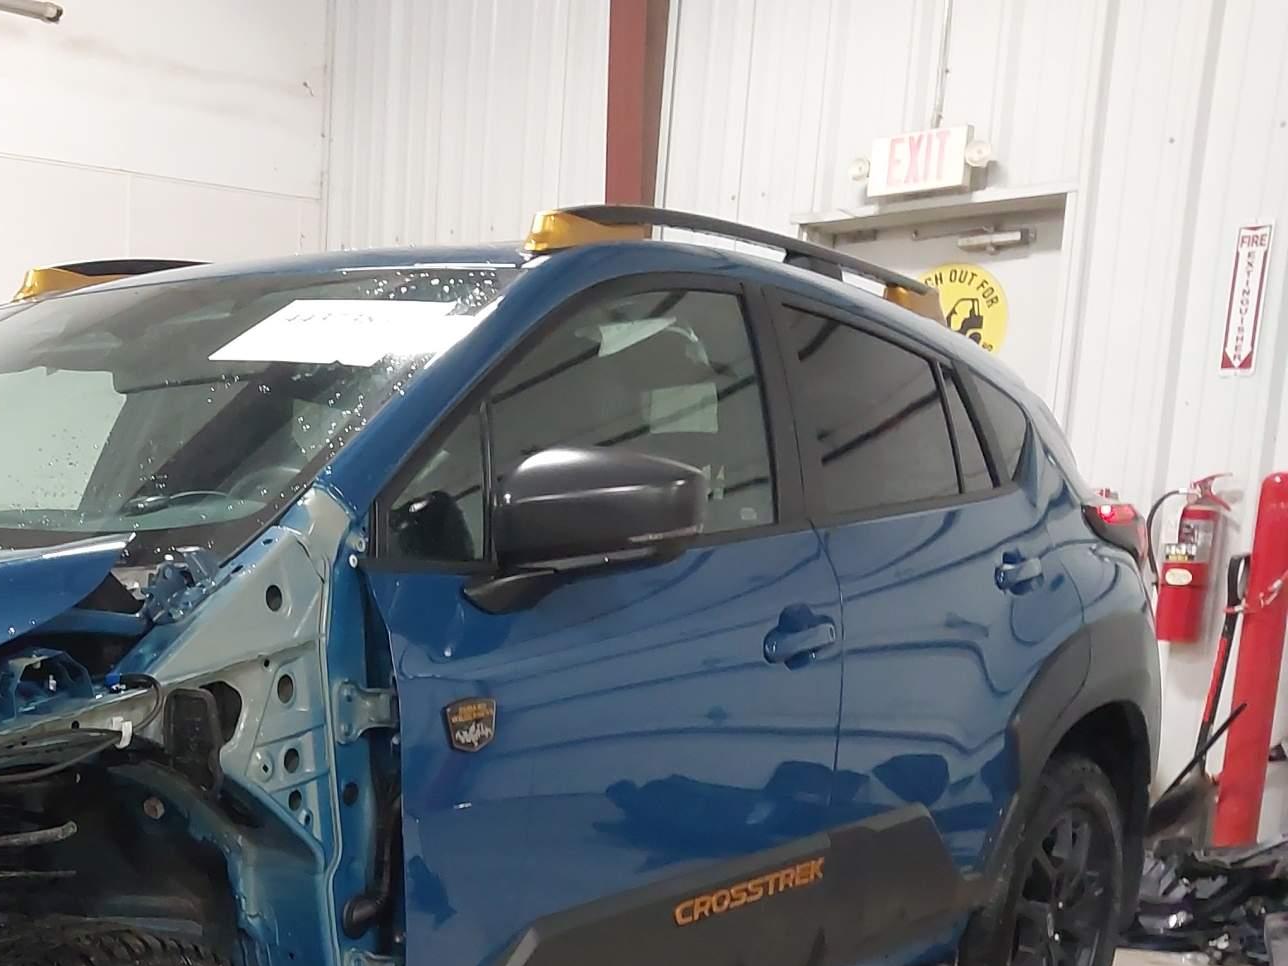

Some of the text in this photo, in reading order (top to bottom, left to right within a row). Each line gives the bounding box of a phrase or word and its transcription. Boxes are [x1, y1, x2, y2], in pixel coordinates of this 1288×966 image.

[886, 129, 950, 187] EXIT
[1240, 233, 1268, 248] FIRE
[949, 268, 977, 286] OUT
[976, 279, 999, 309] FOR
[1233, 251, 1256, 362] EXTINGUISHER
[674, 856, 825, 926] CROSSTREK
